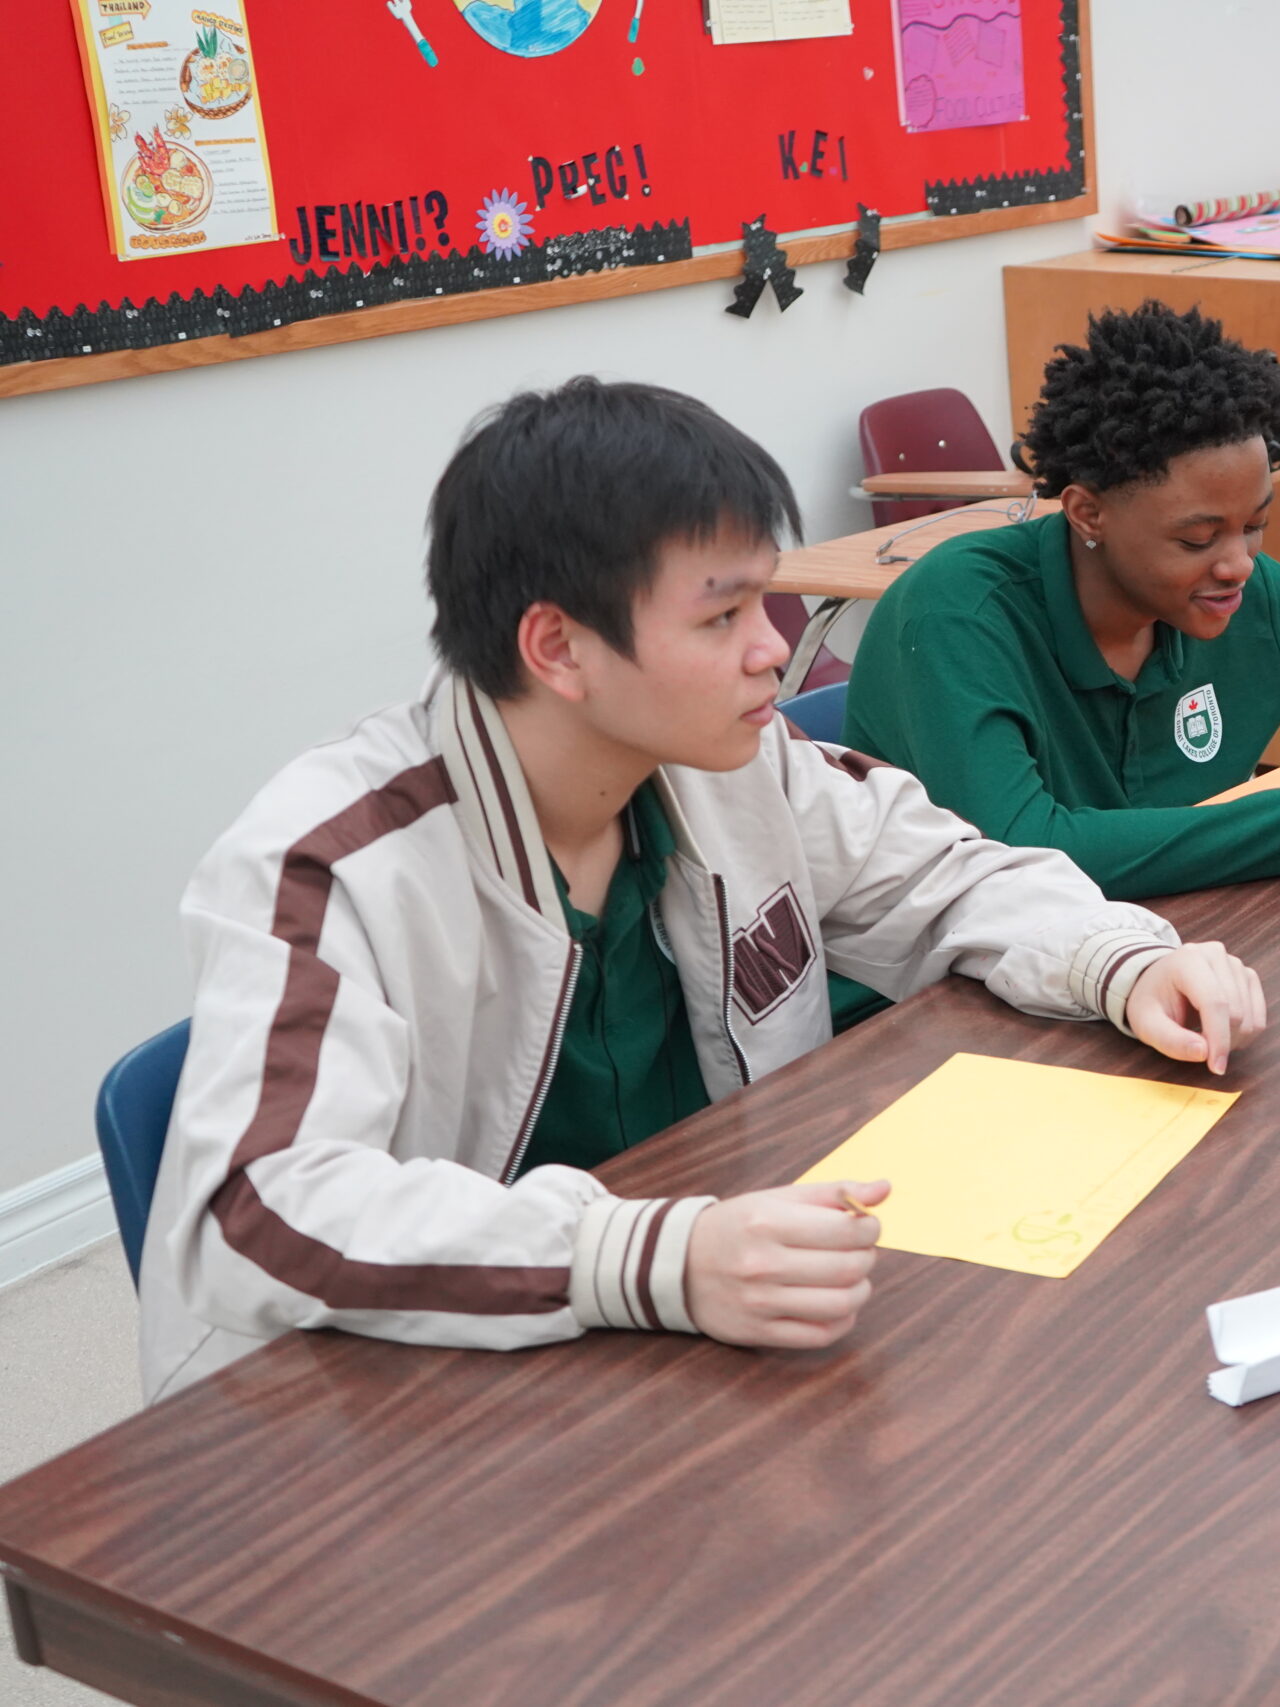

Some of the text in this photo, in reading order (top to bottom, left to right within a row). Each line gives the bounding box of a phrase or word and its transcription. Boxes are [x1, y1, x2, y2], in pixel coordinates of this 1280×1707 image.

[288, 190, 450, 265] JENNI!?
[1206, 689, 1219, 726] TORONTO
[1213, 729, 1219, 738] OF
[1182, 741, 1198, 758] LAKES
[1199, 739, 1217, 758] COLLEGE
